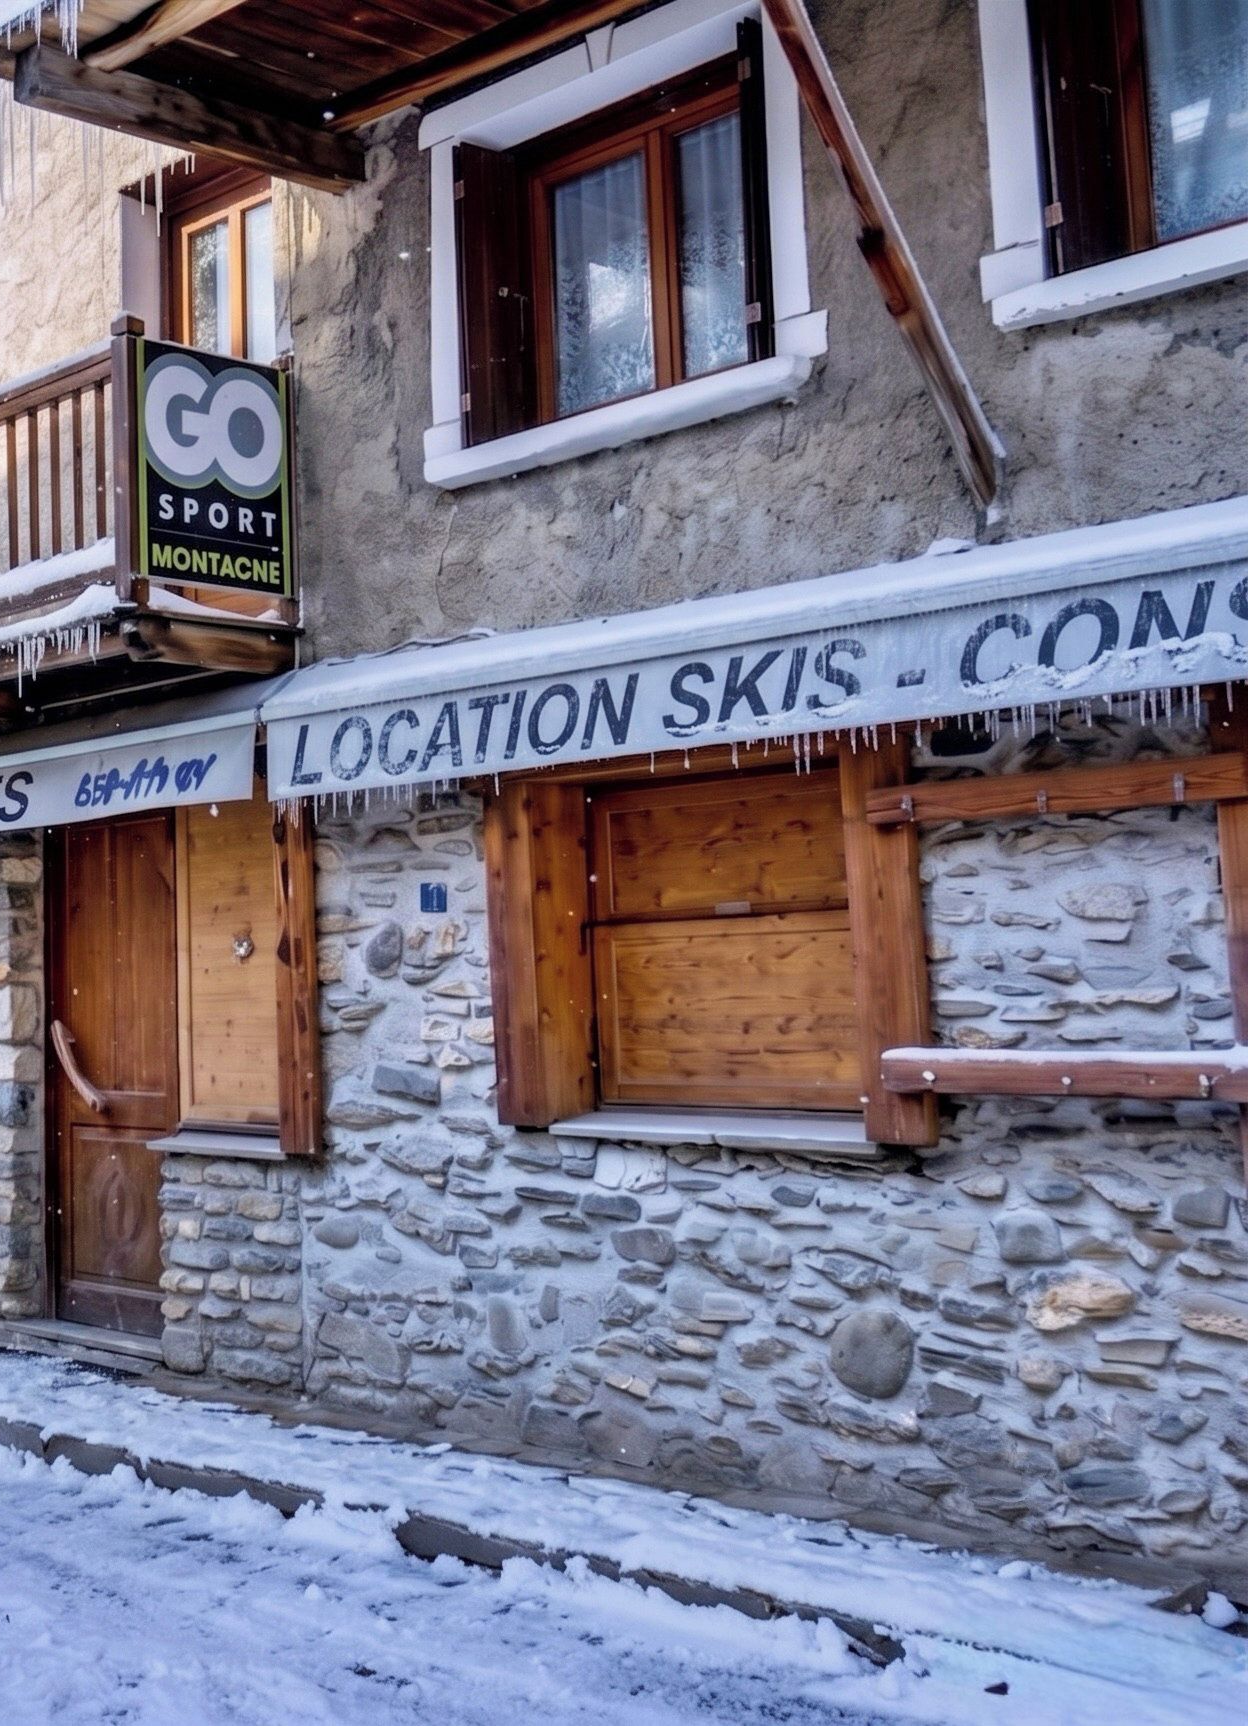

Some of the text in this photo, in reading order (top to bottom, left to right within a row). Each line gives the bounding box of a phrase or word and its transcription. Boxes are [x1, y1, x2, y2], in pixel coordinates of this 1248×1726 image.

[145, 364, 283, 488] GO
[158, 493, 277, 538] SPORT
[290, 671, 641, 787] LOCATION
[662, 638, 868, 738] SKIS
